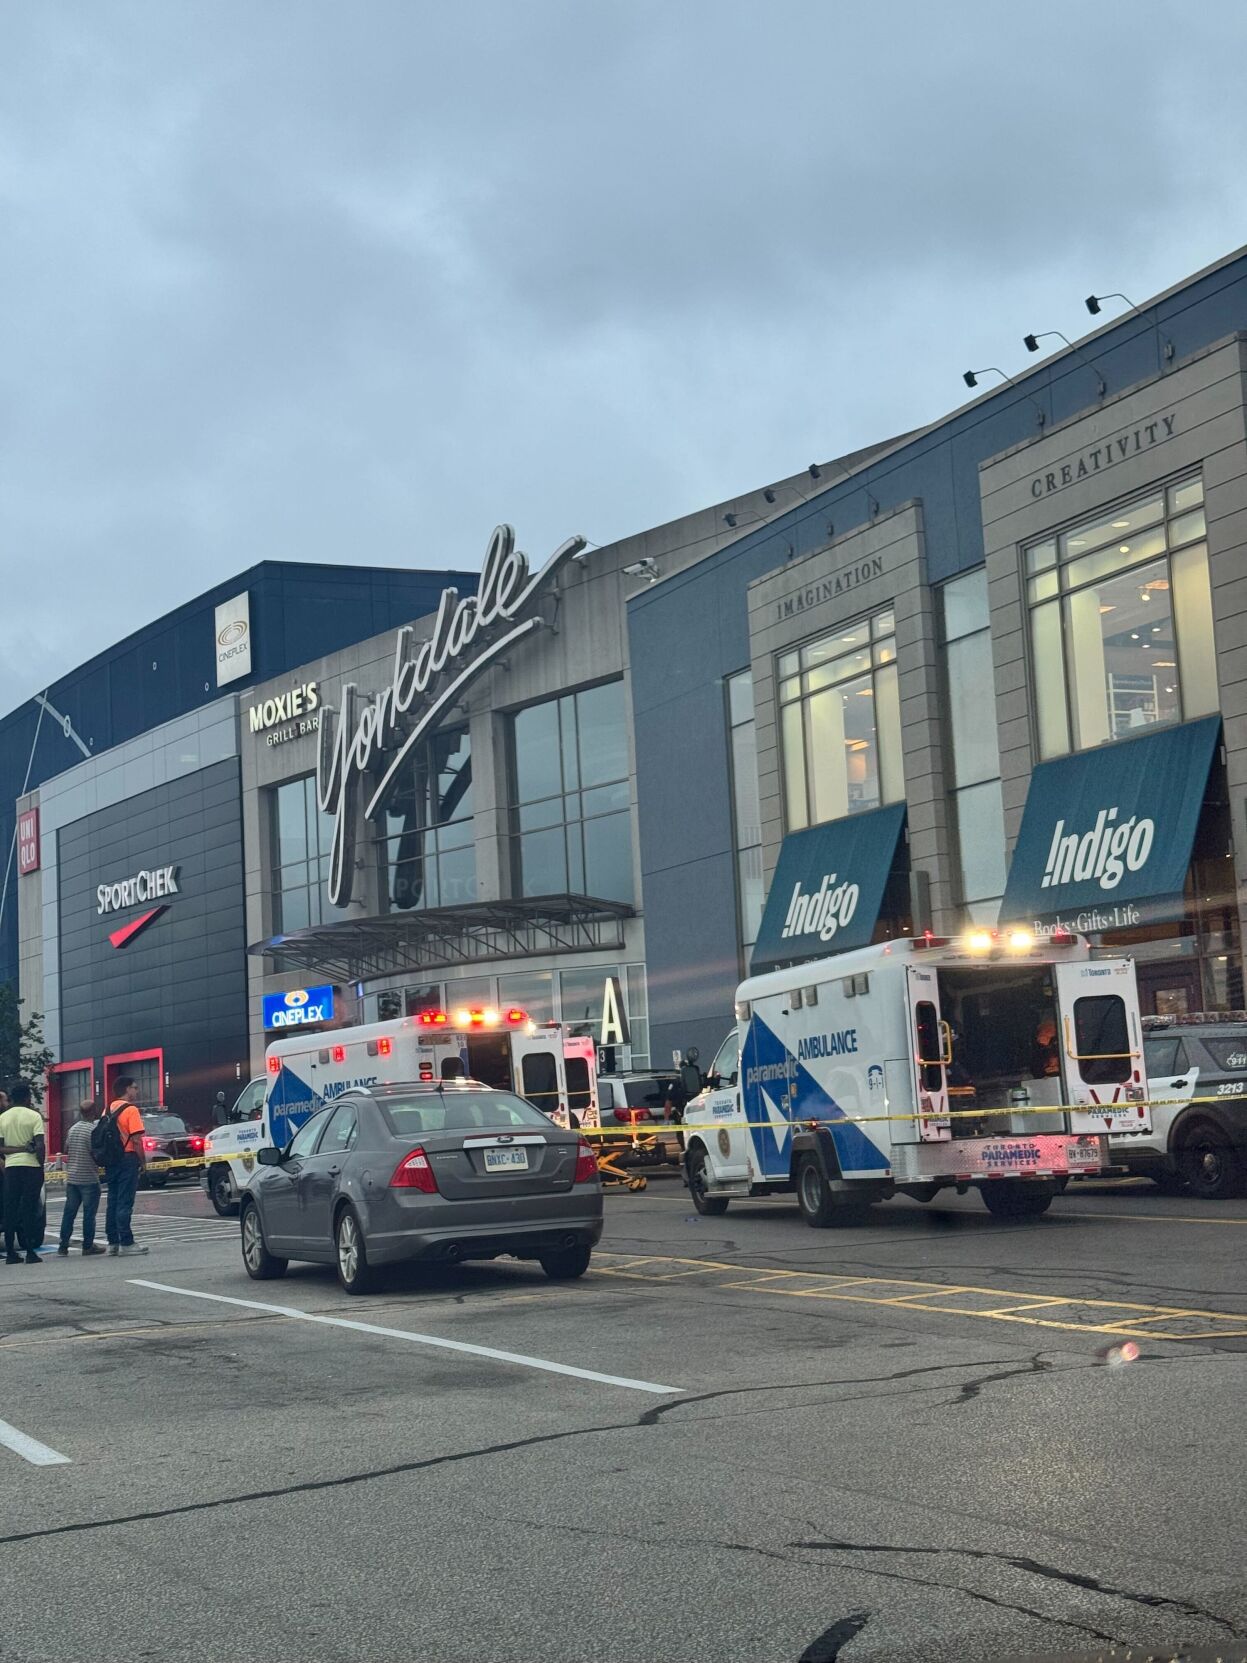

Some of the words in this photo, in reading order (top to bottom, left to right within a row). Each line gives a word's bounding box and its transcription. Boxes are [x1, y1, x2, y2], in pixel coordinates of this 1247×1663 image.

[1031, 413, 1177, 499] CREATIVITY
[777, 556, 883, 620] IMAGINATION
[218, 641, 248, 662] CINEPLEX
[249, 682, 319, 733] MOXIE'S
[317, 524, 586, 905] Yorkdale
[266, 729, 295, 747] GRILL
[300, 717, 319, 735] BAR
[20, 818, 35, 842] UNI
[20, 843, 36, 866] QLO
[97, 866, 177, 914] SPORTCHEK
[1077, 909, 1108, 932] Gifts
[1113, 904, 1140, 927] Life
[272, 1005, 324, 1027] CINEPLEX
[601, 978, 624, 1045] A
[798, 1029, 858, 1060] AMBULANCE
[747, 1055, 799, 1088] paramedic
[1217, 1082, 1244, 1095] 3213
[982, 1149, 1040, 1160] PARAMEDIC
[985, 1143, 1036, 1151] TORONTO
